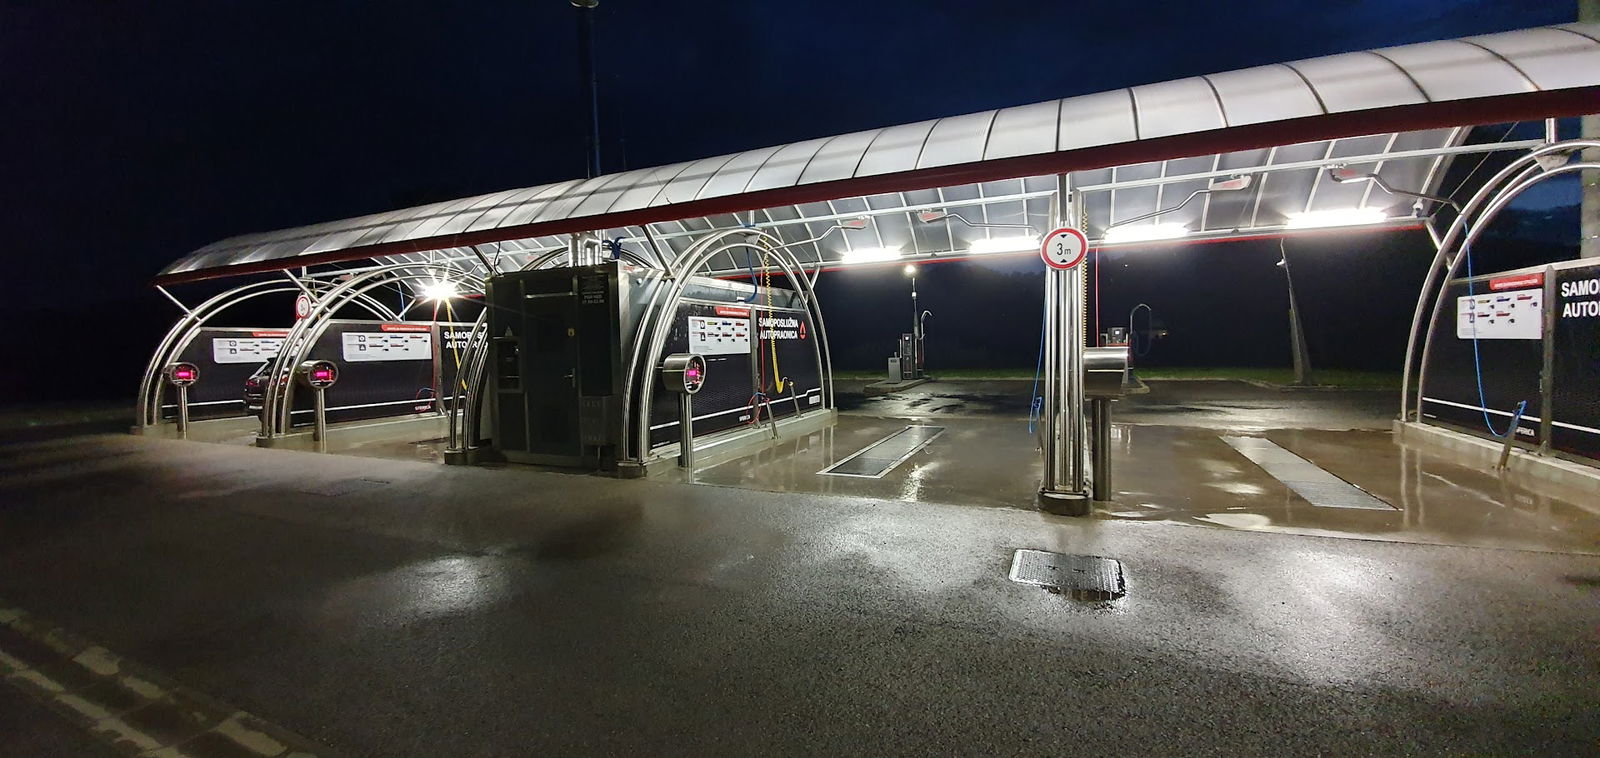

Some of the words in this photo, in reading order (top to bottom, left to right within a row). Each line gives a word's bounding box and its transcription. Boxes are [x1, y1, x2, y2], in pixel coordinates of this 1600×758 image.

[1057, 243, 1063, 255] 3
[1561, 279, 1600, 297] SAMO
[1563, 301, 1600, 317] AUTO
